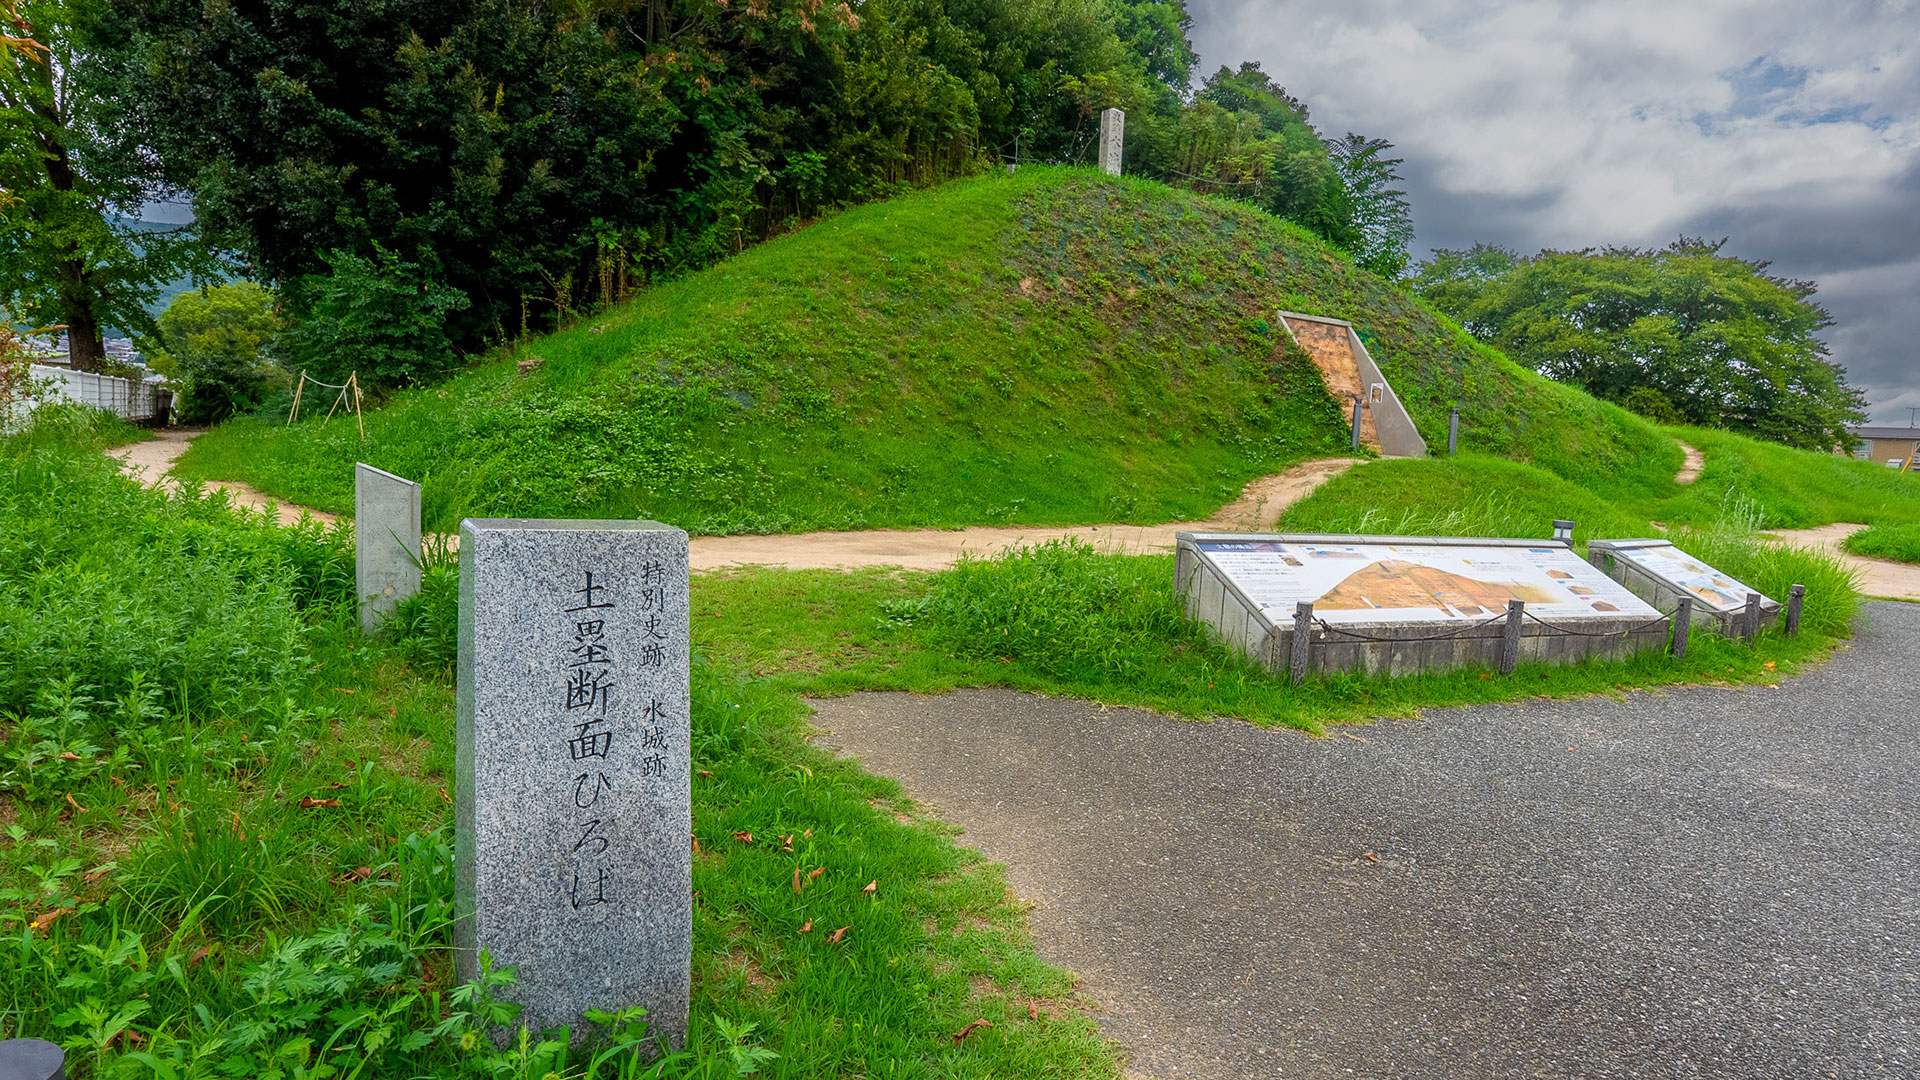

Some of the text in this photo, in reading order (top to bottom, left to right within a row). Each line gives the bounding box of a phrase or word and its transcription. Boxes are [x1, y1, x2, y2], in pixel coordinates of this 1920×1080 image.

[565, 572, 614, 909] 土塁断面ひろば
[642, 562, 668, 777] 特別史跡 水城跡
